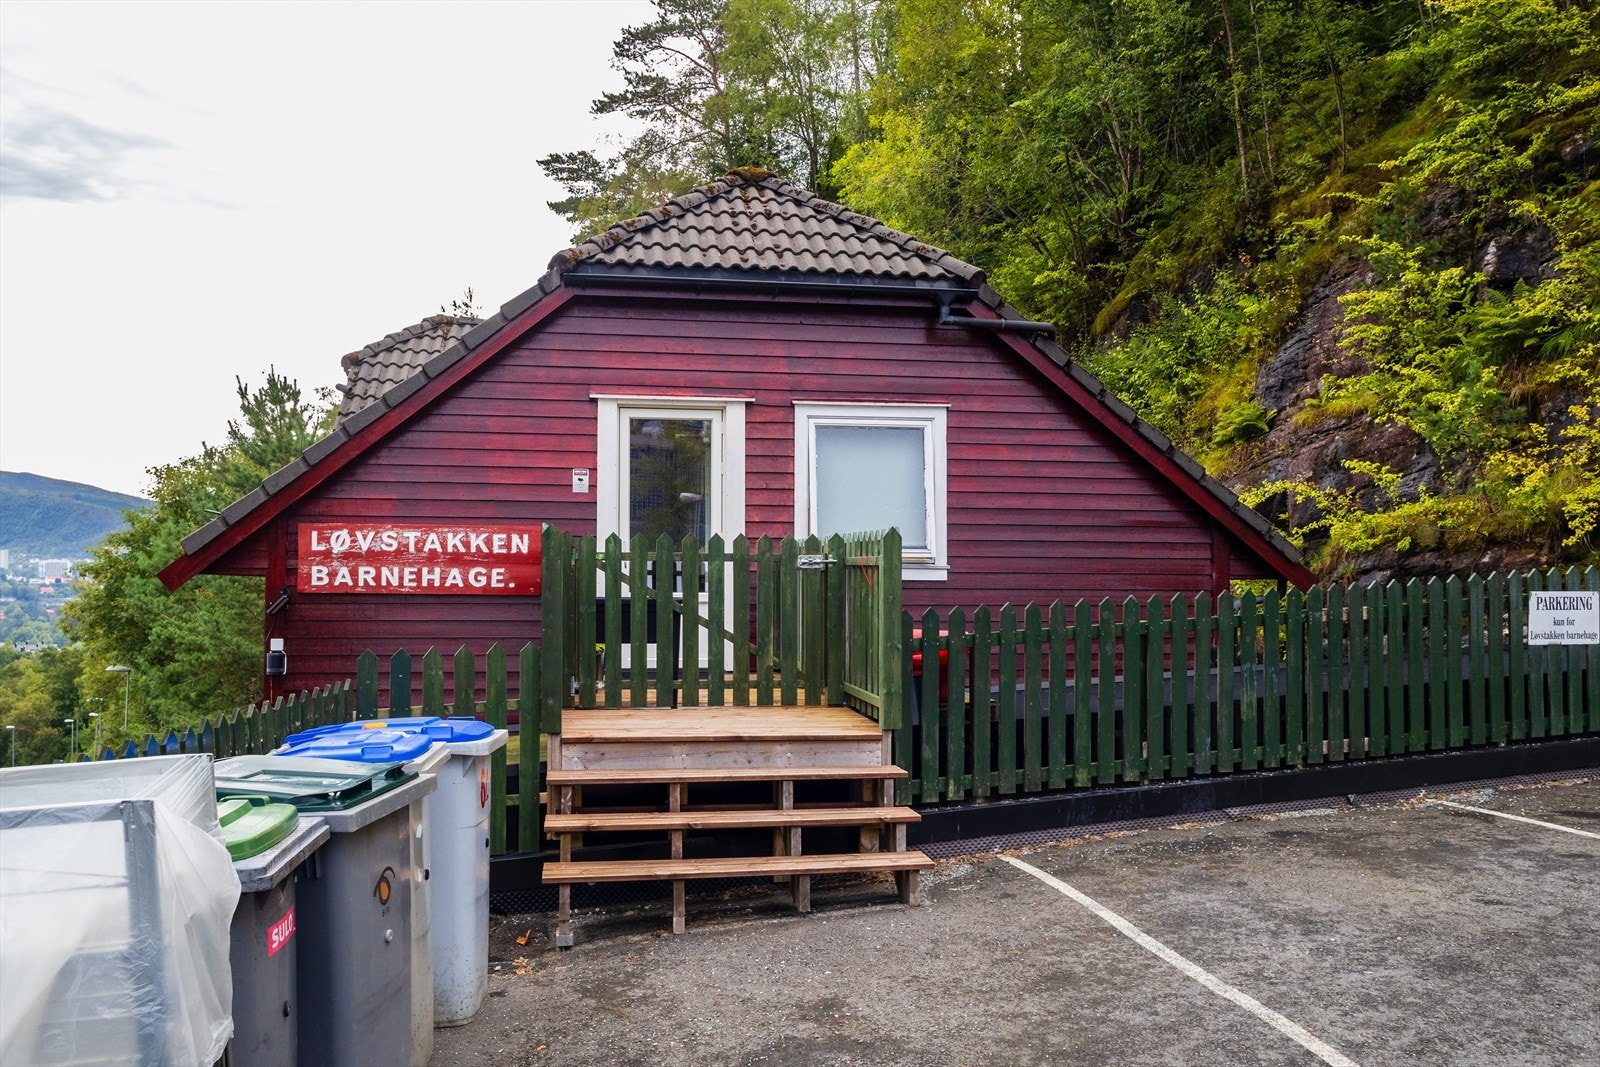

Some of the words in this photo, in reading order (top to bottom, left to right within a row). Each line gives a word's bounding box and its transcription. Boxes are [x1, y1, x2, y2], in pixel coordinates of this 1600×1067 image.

[310, 529, 529, 554] LØVSTAKKEN
[310, 565, 516, 588] BARNEHAGE.
[1536, 597, 1592, 611] PARKERING
[1553, 616, 1565, 626] kun
[1566, 616, 1575, 626] for
[1566, 630, 1598, 641] barnehage
